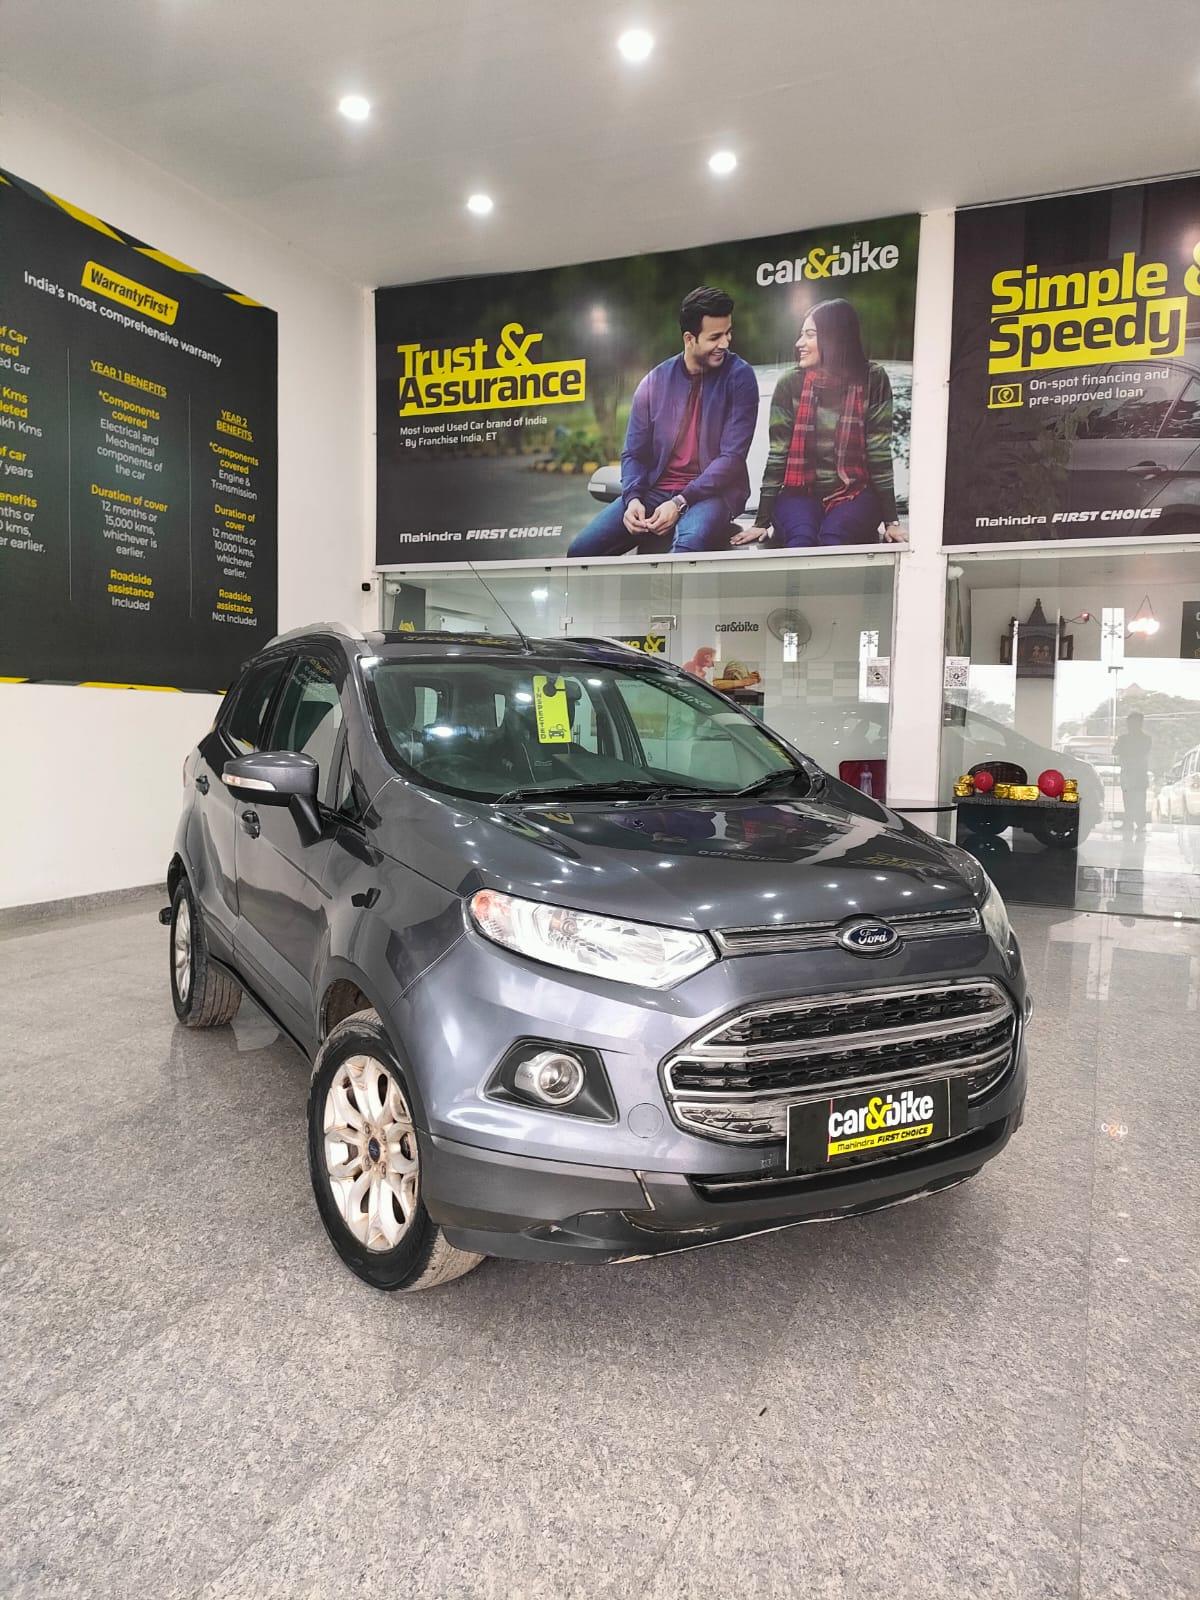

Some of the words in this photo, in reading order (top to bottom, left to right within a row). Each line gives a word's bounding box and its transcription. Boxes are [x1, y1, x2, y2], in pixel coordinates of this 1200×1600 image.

[756, 240, 899, 286] car&bike
[91, 268, 169, 316] WarrantyFirst
[991, 252, 1167, 313] Simple
[24, 270, 65, 298] India's
[67, 291, 97, 312] most
[99, 306, 179, 347] comprehensive
[180, 341, 222, 368] warranty
[9, 329, 28, 344] Car
[989, 305, 1181, 368] Speedy
[397, 338, 488, 378] Trust
[496, 322, 544, 368] &
[13, 362, 31, 375] car
[90, 359, 117, 379] YEAR
[124, 373, 168, 399] BENEFITS
[1029, 376, 1079, 391] On-spot
[1082, 371, 1141, 386] financing
[1144, 367, 1170, 380] and
[3, 386, 28, 404] Kms
[400, 369, 582, 409] Assurance
[1029, 387, 1112, 408] pre-approved
[1115, 387, 1144, 399] loan
[111, 410, 148, 430] covered
[221, 409, 241, 426] YEAR
[242, 417, 248, 428] 2
[400, 427, 420, 435] Most
[422, 424, 445, 434] loved
[446, 421, 468, 432] Used
[470, 421, 484, 430] Car
[486, 418, 511, 429] brand
[513, 417, 523, 427] of
[525, 415, 548, 425] India
[18, 421, 43, 438] Kms
[100, 418, 141, 440] Electrical
[142, 433, 159, 446] and
[216, 420, 254, 443] BENEFITS
[105, 433, 155, 457] Mechanical
[405, 438, 417, 449] By
[418, 434, 459, 446] Franchise
[460, 432, 484, 442] India,
[486, 431, 497, 441] ET
[9, 450, 27, 462] car
[97, 446, 153, 470] components
[153, 462, 163, 473] of
[5, 463, 34, 479] years
[115, 464, 131, 477] the
[131, 470, 146, 481] car
[220, 459, 249, 475] covered
[218, 469, 244, 485] Engine
[244, 478, 251, 487] &
[91, 484, 132, 504] Duration
[133, 496, 143, 507] of
[144, 499, 168, 513] cover
[211, 479, 258, 500] Transmission
[23, 512, 35, 522] or
[101, 500, 111, 512] 12
[112, 504, 148, 520] months
[148, 513, 158, 523] or
[214, 504, 247, 521] Duration
[247, 513, 256, 523] of
[975, 514, 1047, 527] Mahindra
[1052, 511, 1101, 523] FIRST
[1100, 508, 1162, 521] CHOICE
[5, 521, 32, 538] kms,
[104, 514, 134, 530] 15,000
[134, 521, 156, 536] kms,
[225, 520, 245, 531] cover
[400, 531, 462, 543] Mahindra
[466, 528, 508, 540] FIRST
[509, 526, 563, 538] CHOICE
[10, 538, 46, 554] earlier.
[102, 529, 149, 547] whichever
[150, 537, 158, 548] is
[212, 527, 220, 538] 12
[220, 530, 248, 545] months
[249, 538, 257, 546] or
[214, 540, 238, 554] 10,000
[238, 546, 255, 559] kms,
[216, 553, 253, 569] whichever
[110, 569, 153, 586] Roadside
[223, 567, 247, 579] earlier.
[107, 583, 155, 599] assistance
[219, 588, 252, 603] Roadside
[111, 597, 150, 611] Included
[216, 601, 254, 615] assistance
[212, 611, 226, 622] Not
[226, 613, 257, 627] Included
[715, 621, 759, 632] car&bike
[858, 928, 888, 945] Ford
[828, 1091, 934, 1137] car&bike
[837, 1139, 875, 1152] Mahindra
[877, 1132, 901, 1144] FIRST
[900, 1126, 929, 1138] CHOICE
